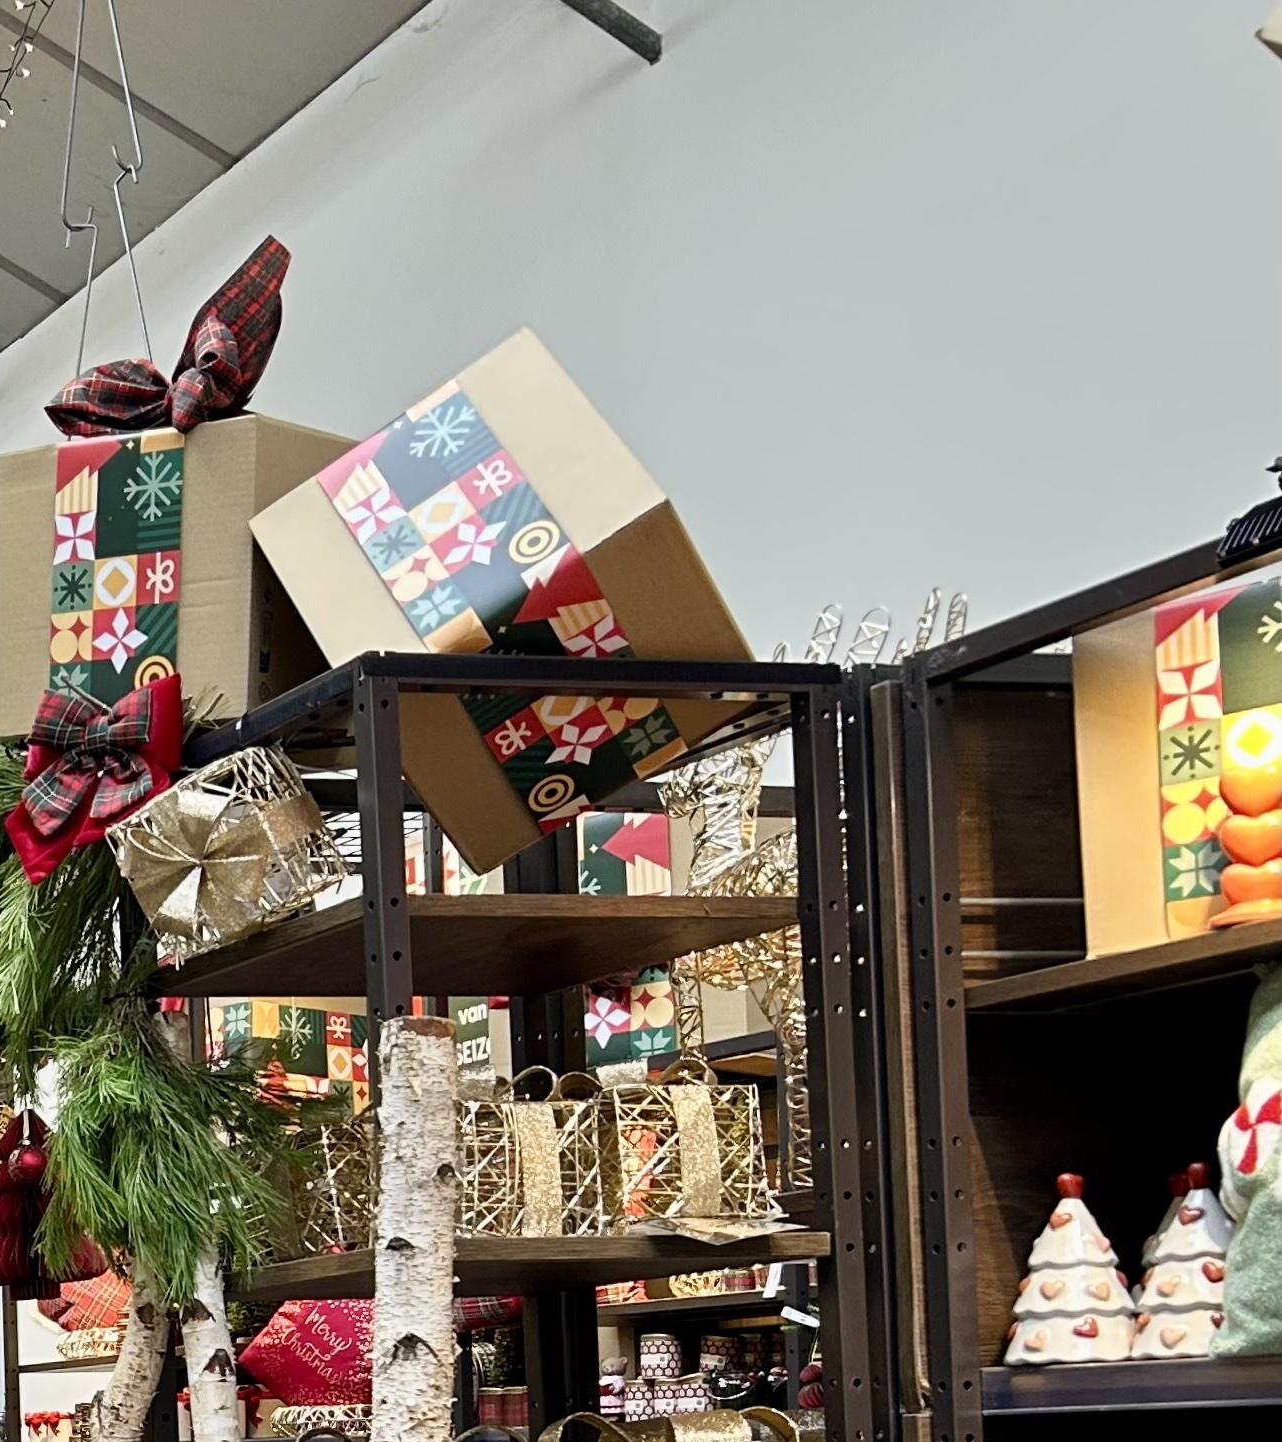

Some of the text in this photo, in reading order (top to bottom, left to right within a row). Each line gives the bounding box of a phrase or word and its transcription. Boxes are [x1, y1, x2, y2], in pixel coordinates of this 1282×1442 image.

[457, 1003, 488, 1025] van
[280, 1325, 343, 1384] Christmas
[304, 1305, 353, 1356] Merry
